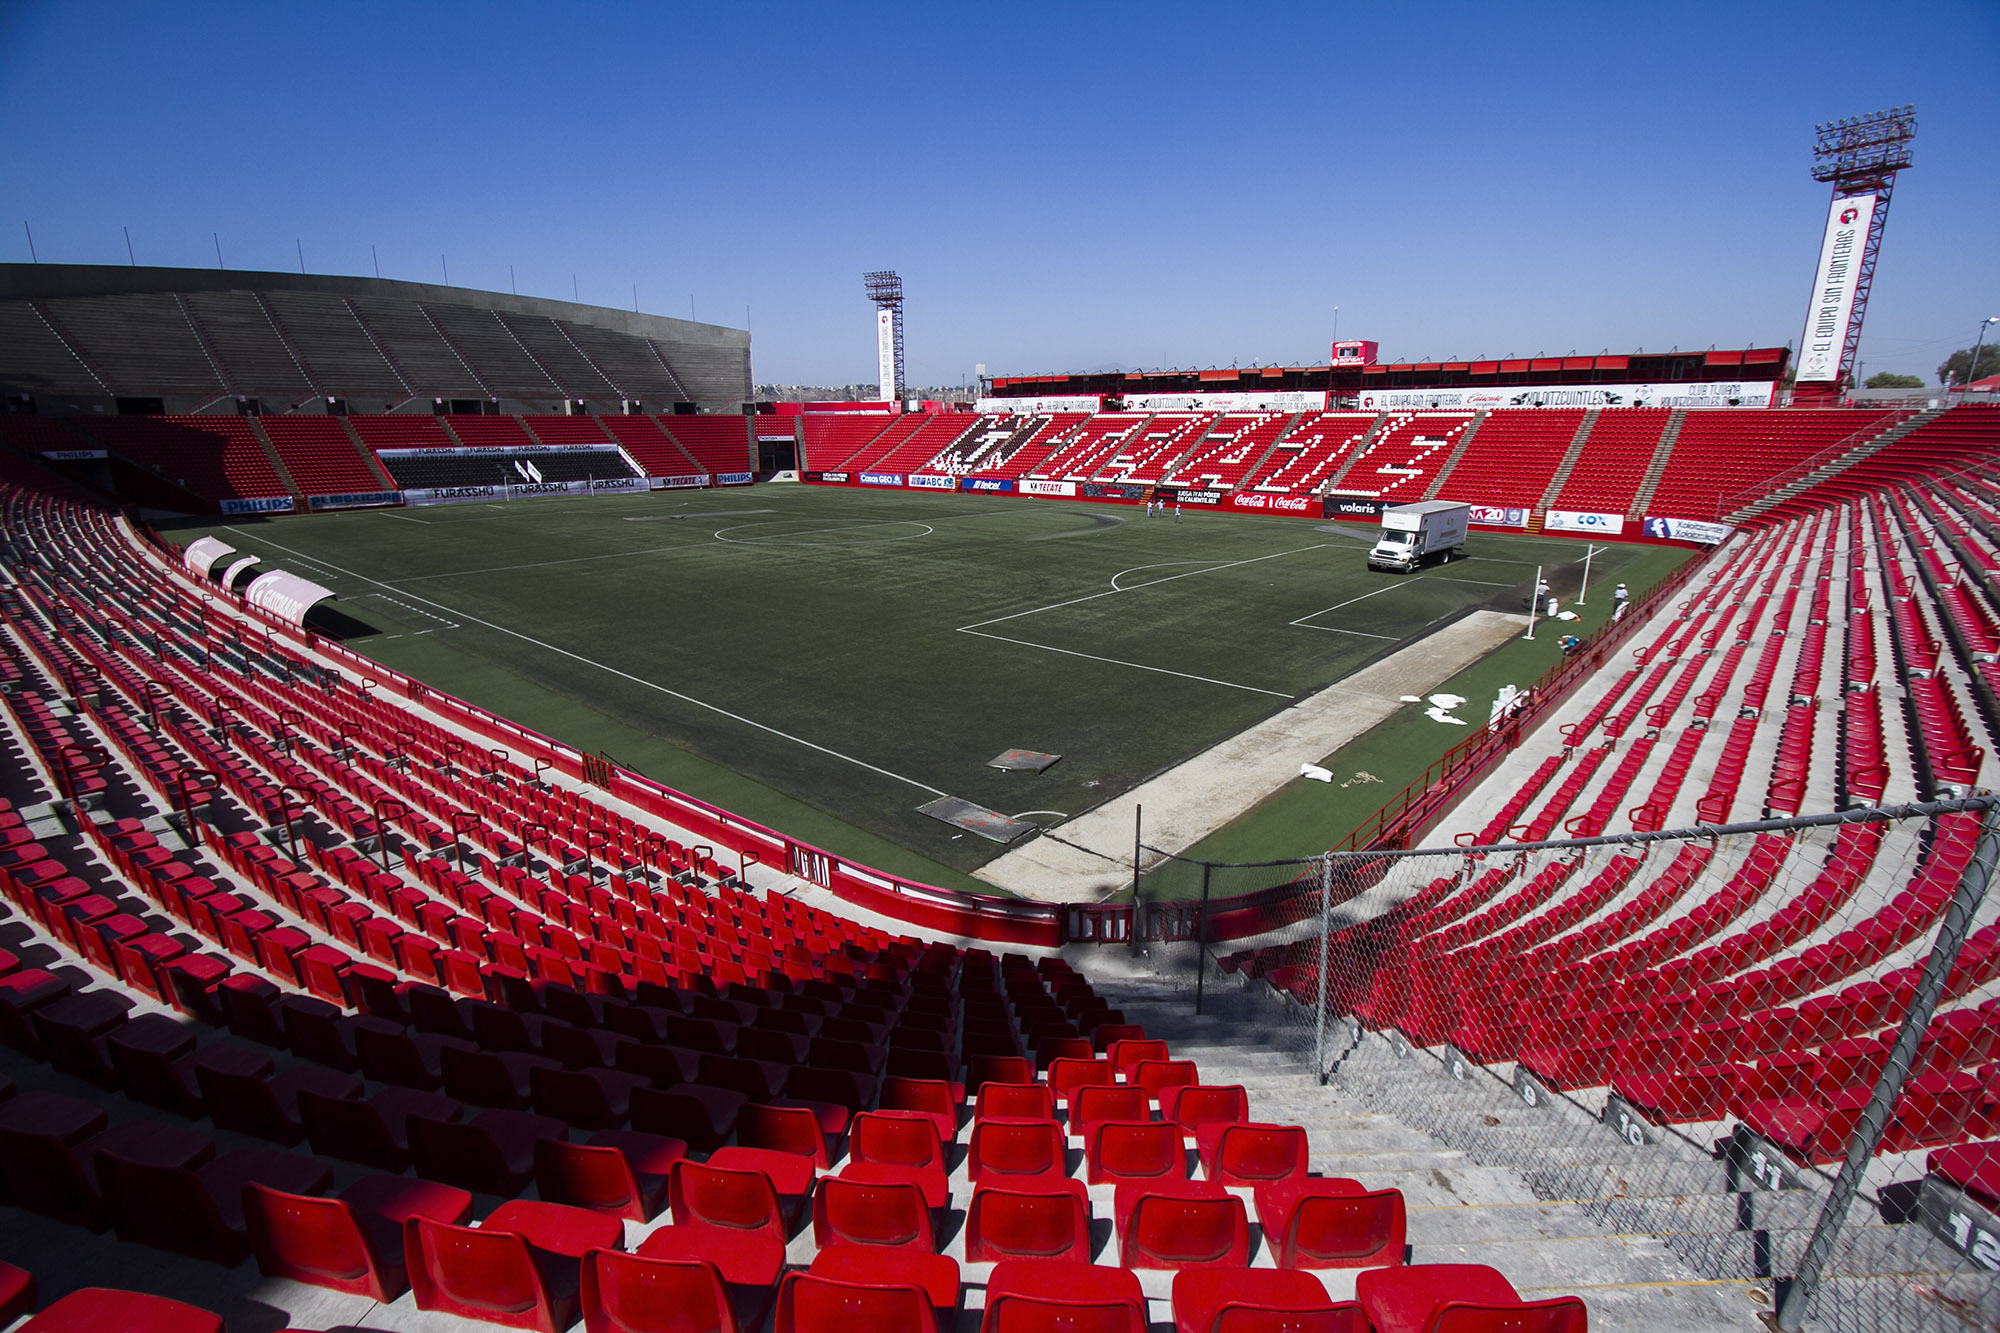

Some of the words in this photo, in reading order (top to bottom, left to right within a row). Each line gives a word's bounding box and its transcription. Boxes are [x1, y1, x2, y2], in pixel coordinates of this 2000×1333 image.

[1826, 229, 1856, 284] FRONTERAS
[1822, 287, 1843, 303] SIN
[1815, 306, 1839, 338] EQUIPO
[1813, 340, 1831, 351] EL
[1381, 395, 1388, 406] EL
[1390, 395, 1411, 406] EQUIPO
[57, 451, 94, 459] PHILIPS
[586, 478, 634, 490] FURASSHU
[672, 476, 696, 485] TECATE
[718, 473, 752, 483] PHILIPS
[860, 475, 878, 484] Casas
[879, 475, 892, 484] GEO
[926, 477, 942, 487] ABC
[514, 483, 568, 495] FURASSHU
[980, 480, 1001, 490] telcel
[1039, 483, 1063, 493] TECATE
[434, 486, 494, 499] FURASSHU
[228, 497, 292, 513] PHILIPS
[1340, 502, 1375, 514] volaris
[262, 589, 303, 623] GATORADE
[277, 829, 288, 841] 8
[365, 839, 375, 851] 7
[569, 864, 578, 874] 4
[625, 871, 634, 882] 3
[1619, 1112, 1645, 1146] 10
[1750, 1151, 1783, 1192] 11
[1948, 1210, 2000, 1272] 12
